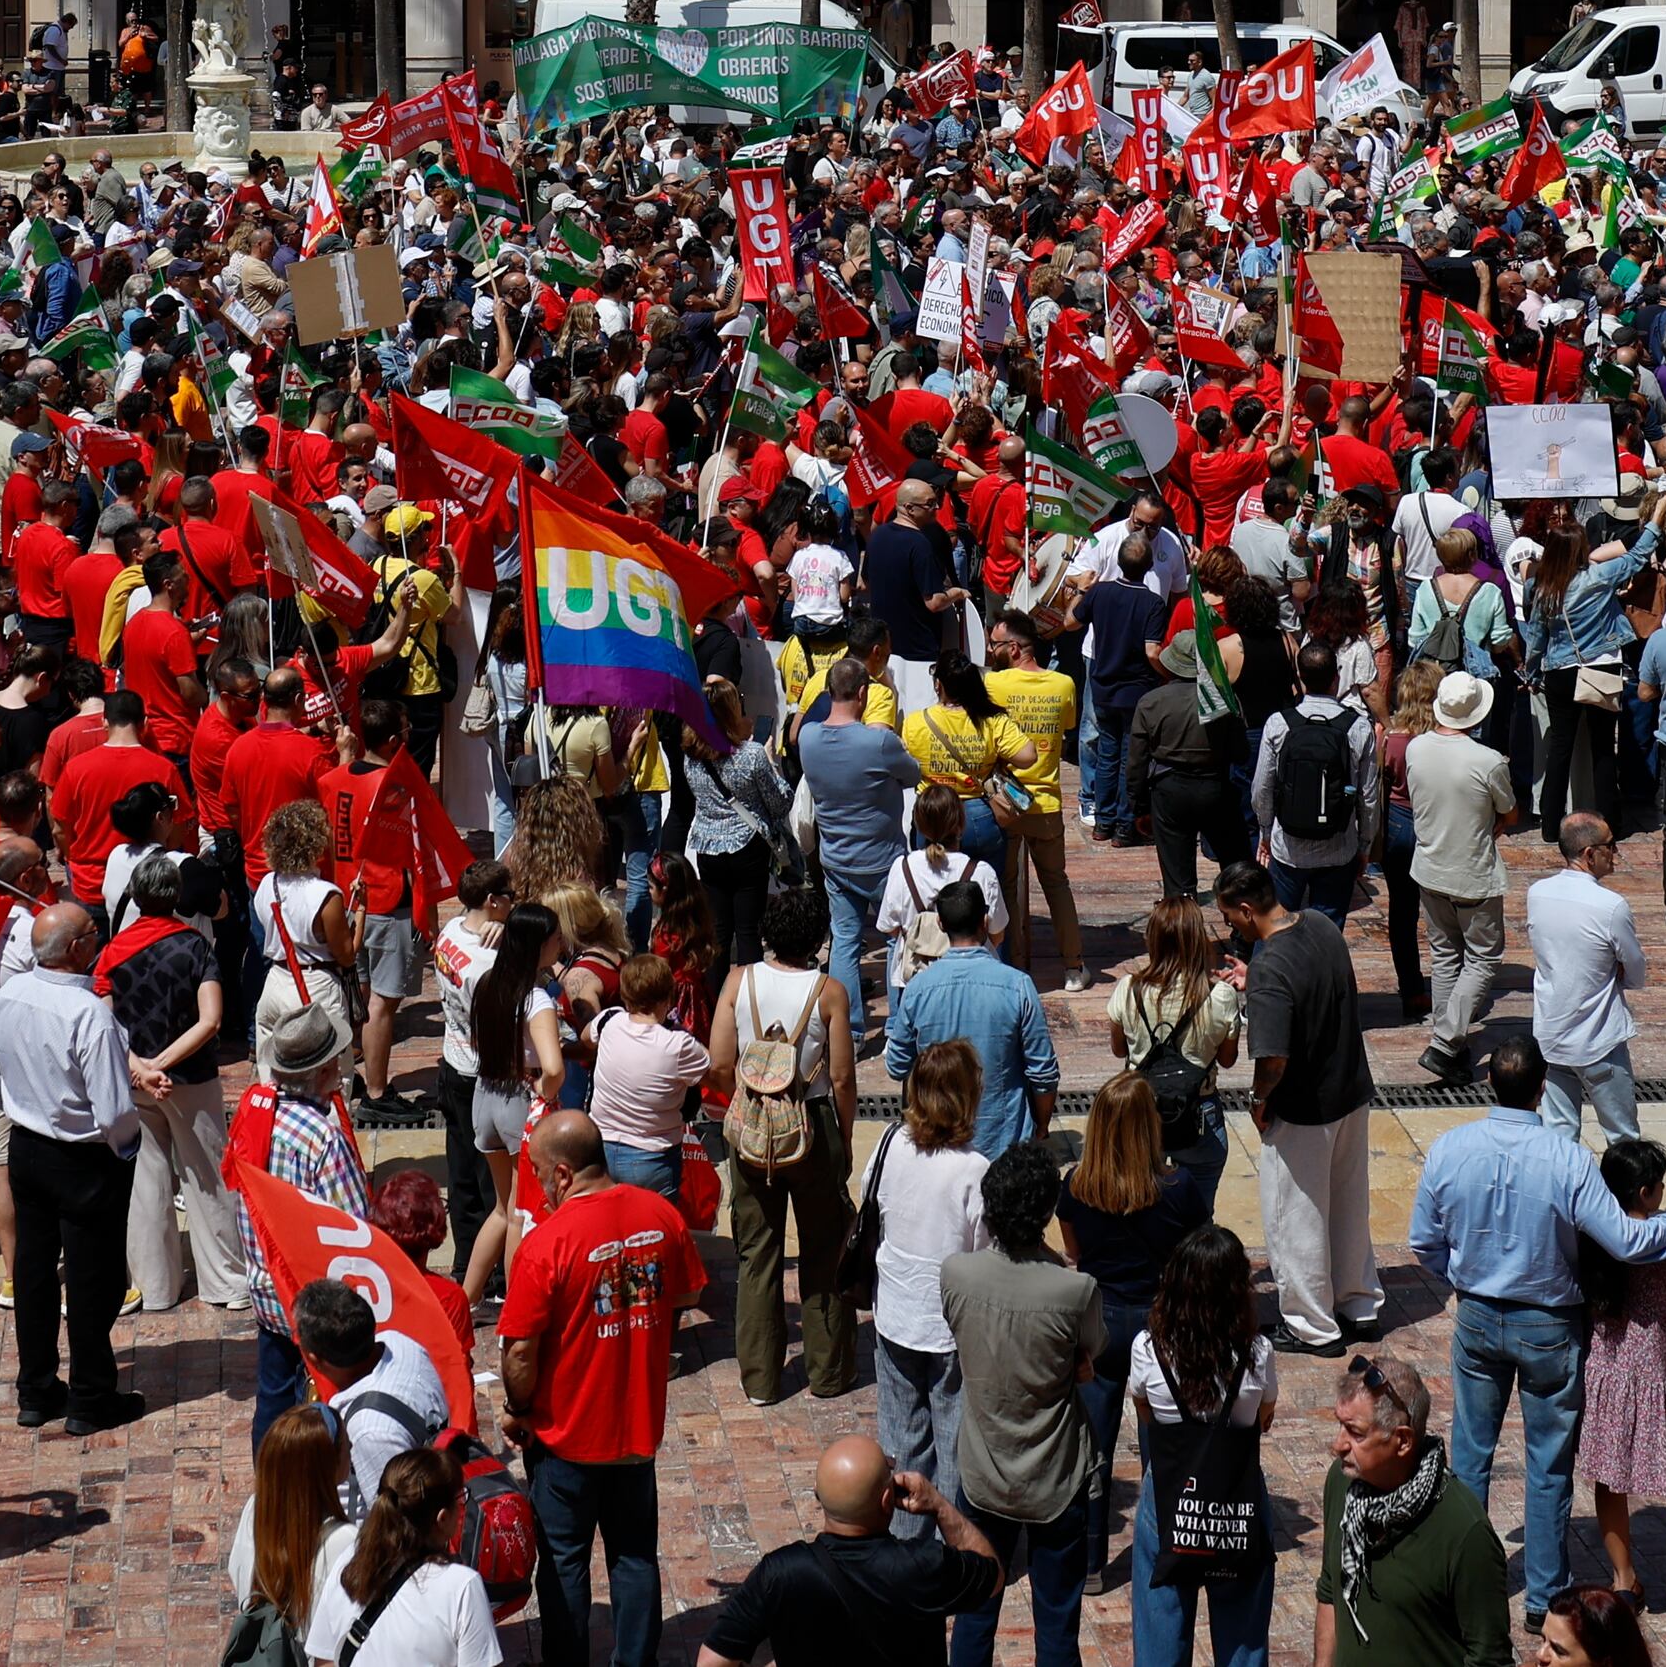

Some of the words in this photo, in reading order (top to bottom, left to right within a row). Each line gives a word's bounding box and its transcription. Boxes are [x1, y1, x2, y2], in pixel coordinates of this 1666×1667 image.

[717, 29, 749, 47] POR
[755, 27, 795, 47] UNOS
[800, 29, 866, 50] BARRIOS
[514, 36, 570, 67] MÁLAGA
[596, 47, 639, 68] VERDE
[644, 47, 653, 64] Y
[717, 56, 790, 76] OBREROS
[574, 73, 653, 104] SOSTENIBLE
[1138, 96, 1159, 193] UGT
[1443, 365, 1478, 381] Málaga
[454, 402, 535, 429] CCOO
[853, 457, 873, 496] industria
[547, 546, 684, 651] UGT
[1007, 695, 1027, 703] STOP
[1028, 695, 1062, 703] DESGUACE
[334, 791, 354, 863] CCOO
[1177, 1498, 1204, 1515] YOU
[1208, 1501, 1235, 1516] CAN
[1237, 1503, 1255, 1517] BE
[1175, 1514, 1248, 1534] WHATEVER
[1172, 1531, 1201, 1546] YOU
[1205, 1534, 1248, 1551] WANT!
